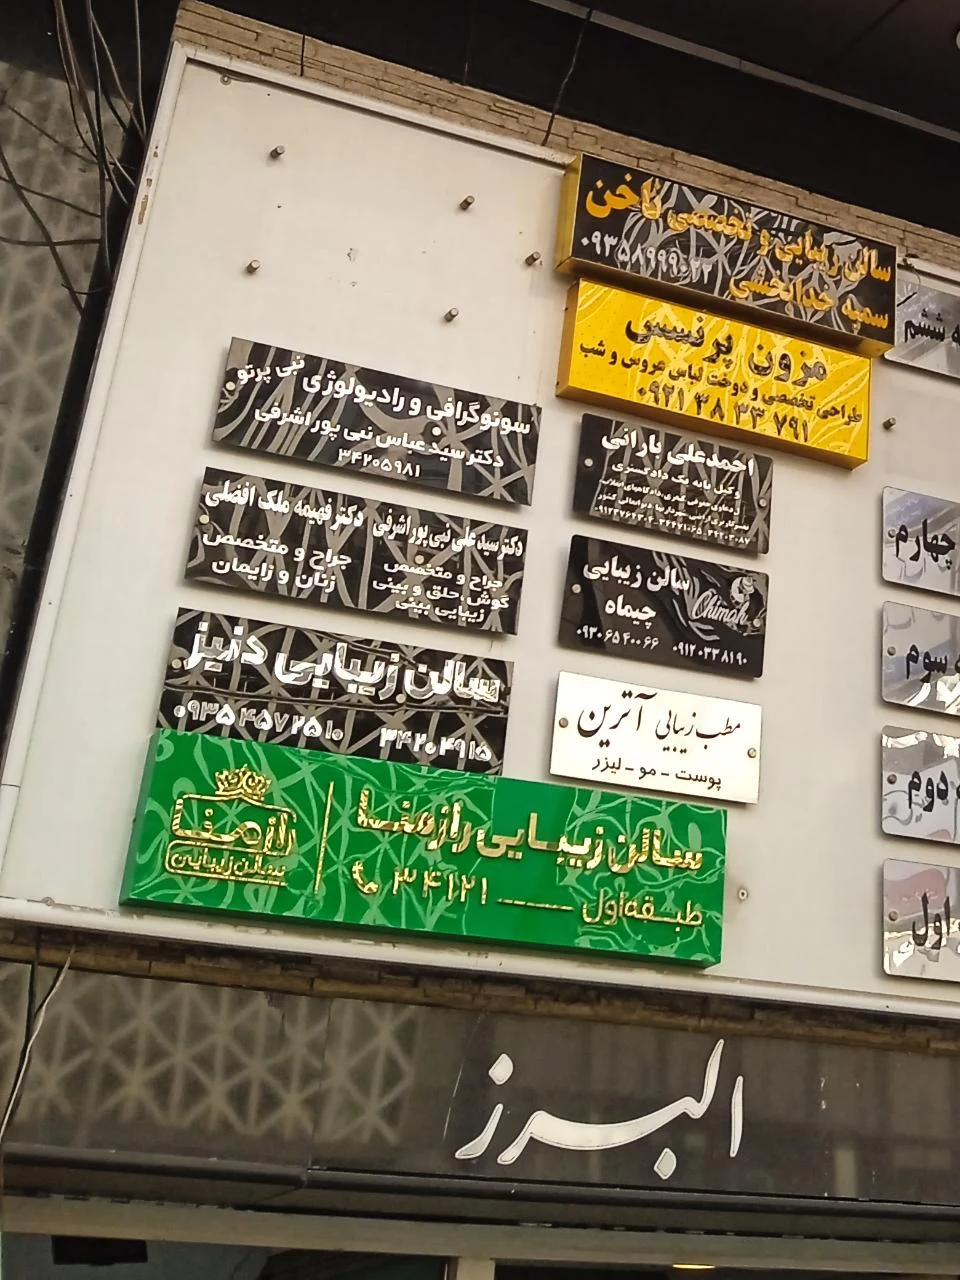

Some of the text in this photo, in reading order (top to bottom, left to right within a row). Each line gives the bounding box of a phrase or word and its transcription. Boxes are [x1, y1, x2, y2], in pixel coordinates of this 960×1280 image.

[584, 173, 662, 220] ناخن
[666, 206, 752, 241] تخصصی
[843, 245, 893, 284] سالن
[904, 306, 946, 344] ششم
[236, 355, 306, 384] نبی پرتو
[579, 338, 863, 426] طراحی تخصصی دوخت لباس عروس شب
[749, 341, 829, 388] مزون
[302, 370, 532, 436] سونوگرافی و رادیولوژی
[637, 379, 811, 444] ۰۹۲۱ ۷۹۱
[254, 402, 505, 469] دکتر سید عباس نبی پور اشرفی
[601, 427, 663, 460] بارانی
[337, 447, 422, 479] ۳۴۲۰۵۹۸۱
[611, 462, 669, 481] دادگستری
[204, 479, 364, 531] دکتر فهیمه ملک افضلی
[713, 482, 741, 500] وکیل
[202, 532, 352, 571] جراح و متخصص
[372, 508, 524, 561] دکتر سید علی نبی پور اشرفی
[894, 518, 956, 570] چهارم
[211, 557, 337, 593] زنان و زایمان
[372, 576, 409, 595] بینی
[383, 561, 503, 592] جراح متخصص
[583, 554, 691, 592] سالن زیبایی
[395, 596, 485, 623] زیبایی بینی
[604, 593, 657, 630] چیماه
[183, 621, 502, 704] سالن زیبایی دنیز
[905, 643, 948, 684] سوم
[576, 689, 741, 755] مطب زیبایی آترین
[591, 756, 722, 792] پوست مو لیزر
[908, 769, 950, 812] دوم
[476, 811, 604, 871] زیبایی
[607, 827, 704, 874] سالن
[392, 866, 704, 933] ۳۴۱۲۱ طبقه اول
[911, 891, 951, 950] اول
[454, 1038, 744, 1181] البرز
